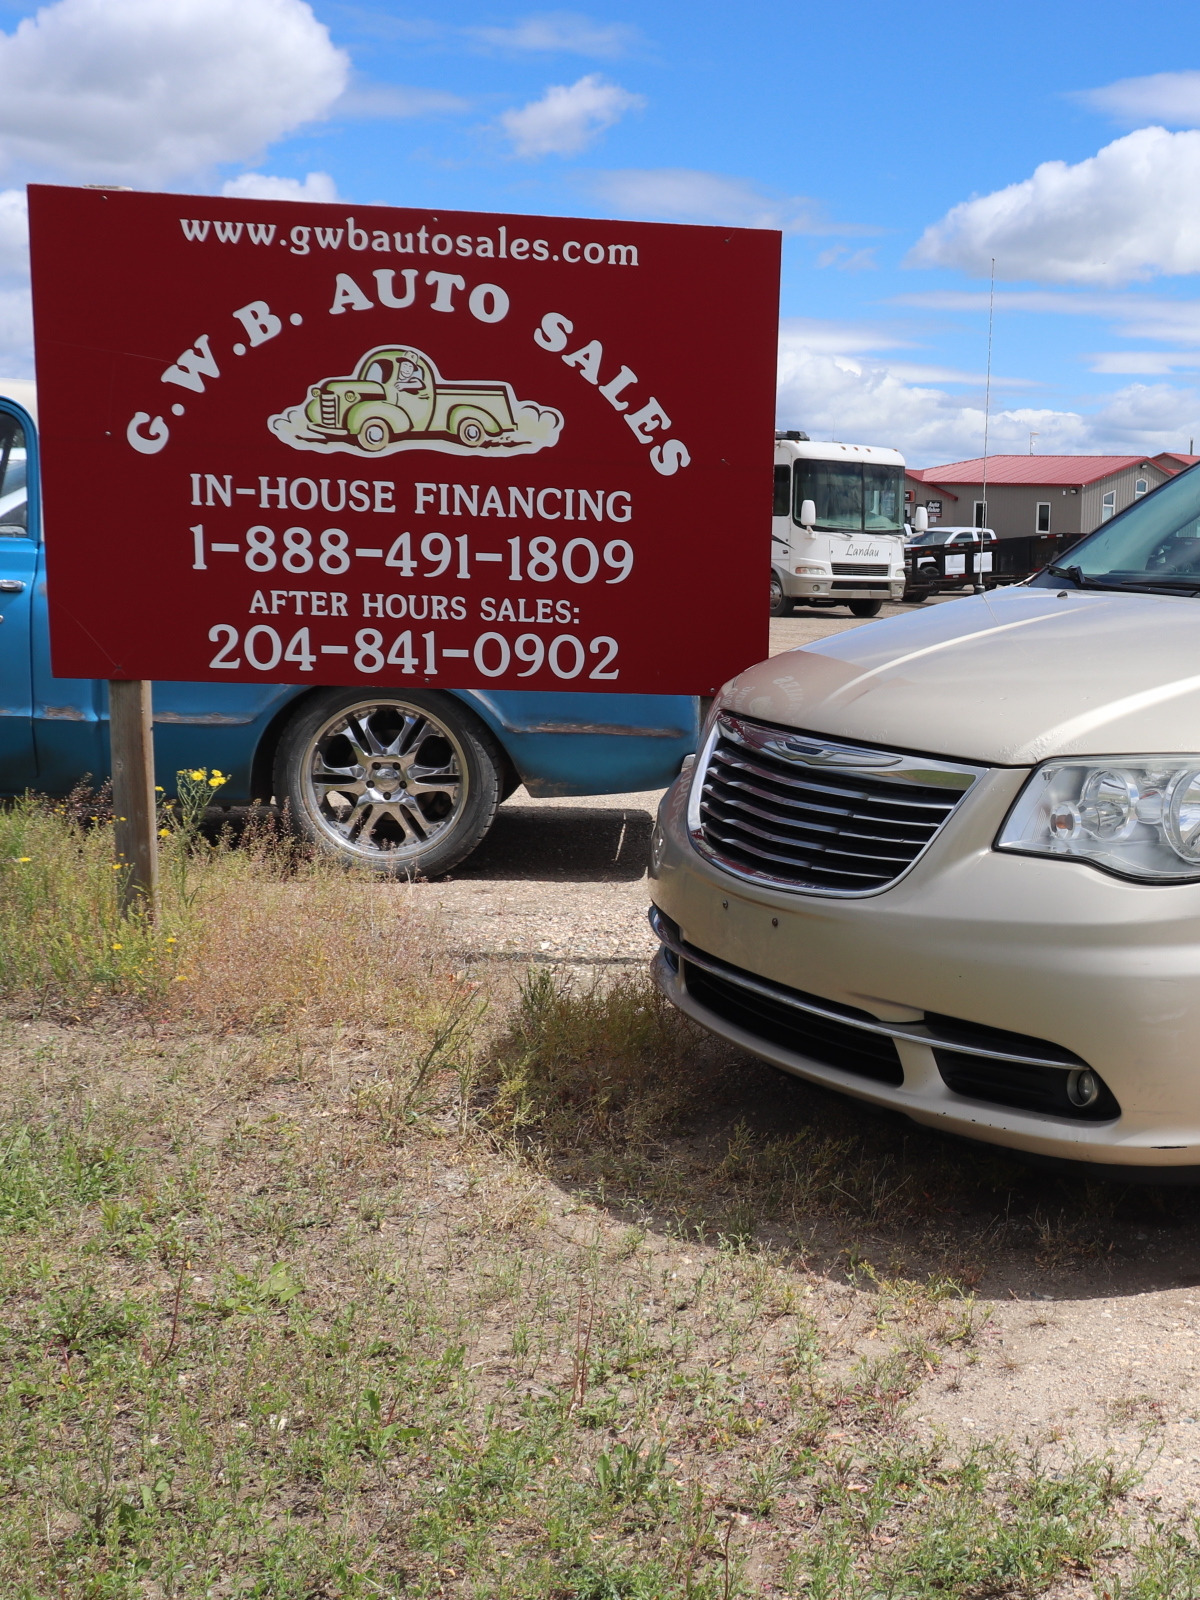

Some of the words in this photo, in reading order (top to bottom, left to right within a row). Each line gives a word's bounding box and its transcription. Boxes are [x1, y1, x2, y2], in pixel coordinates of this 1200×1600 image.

[180, 216, 638, 266] www.gwbautosales.com
[127, 301, 303, 455] G.W.B.
[329, 268, 510, 323] AUTO
[534, 312, 691, 476] SALES
[190, 473, 397, 513] IN-HOUSE
[414, 482, 633, 523] FINANCING
[190, 523, 634, 584] 1-888-491-1809
[845, 543, 880, 557] Landau
[248, 589, 349, 617] AFTER
[362, 593, 467, 621] HOURS
[480, 596, 581, 625] SALES:
[208, 623, 620, 680] 204-841-0902
